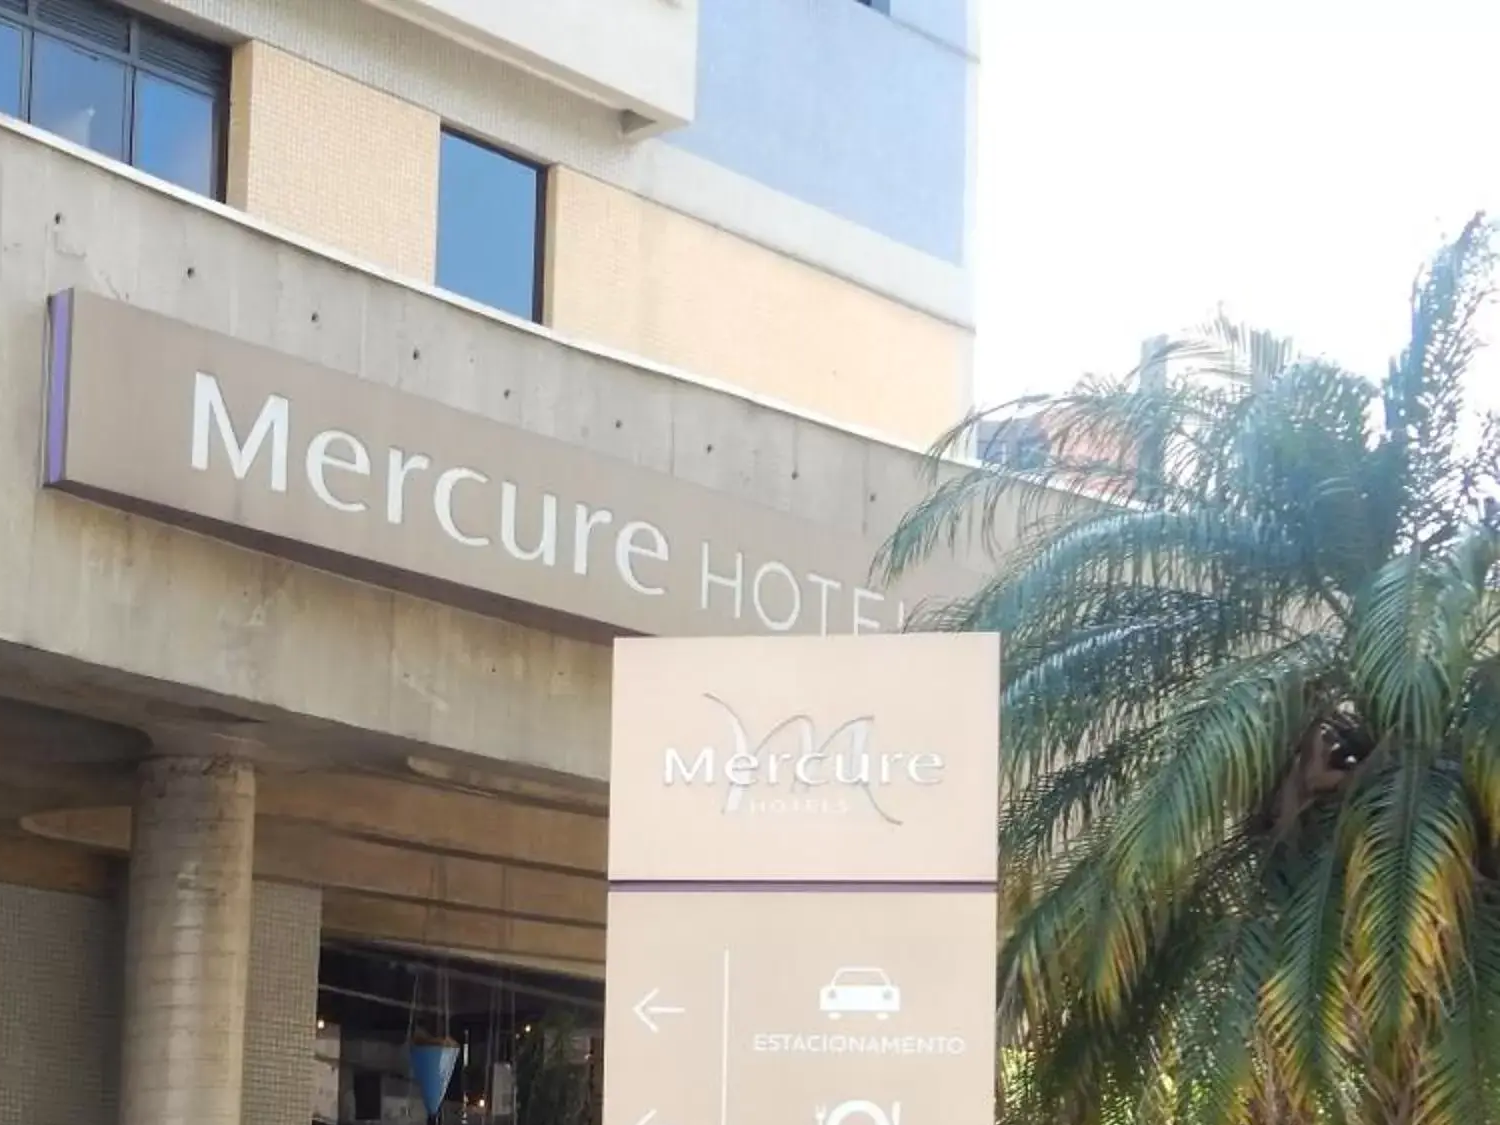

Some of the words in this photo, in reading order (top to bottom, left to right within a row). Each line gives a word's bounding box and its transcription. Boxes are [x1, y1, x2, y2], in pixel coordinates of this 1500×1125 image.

[192, 371, 670, 596] Mercure
[662, 747, 946, 786] Mercure
[749, 797, 851, 815] HOTELS
[753, 1033, 967, 1055] ESTACIONAMENTO
